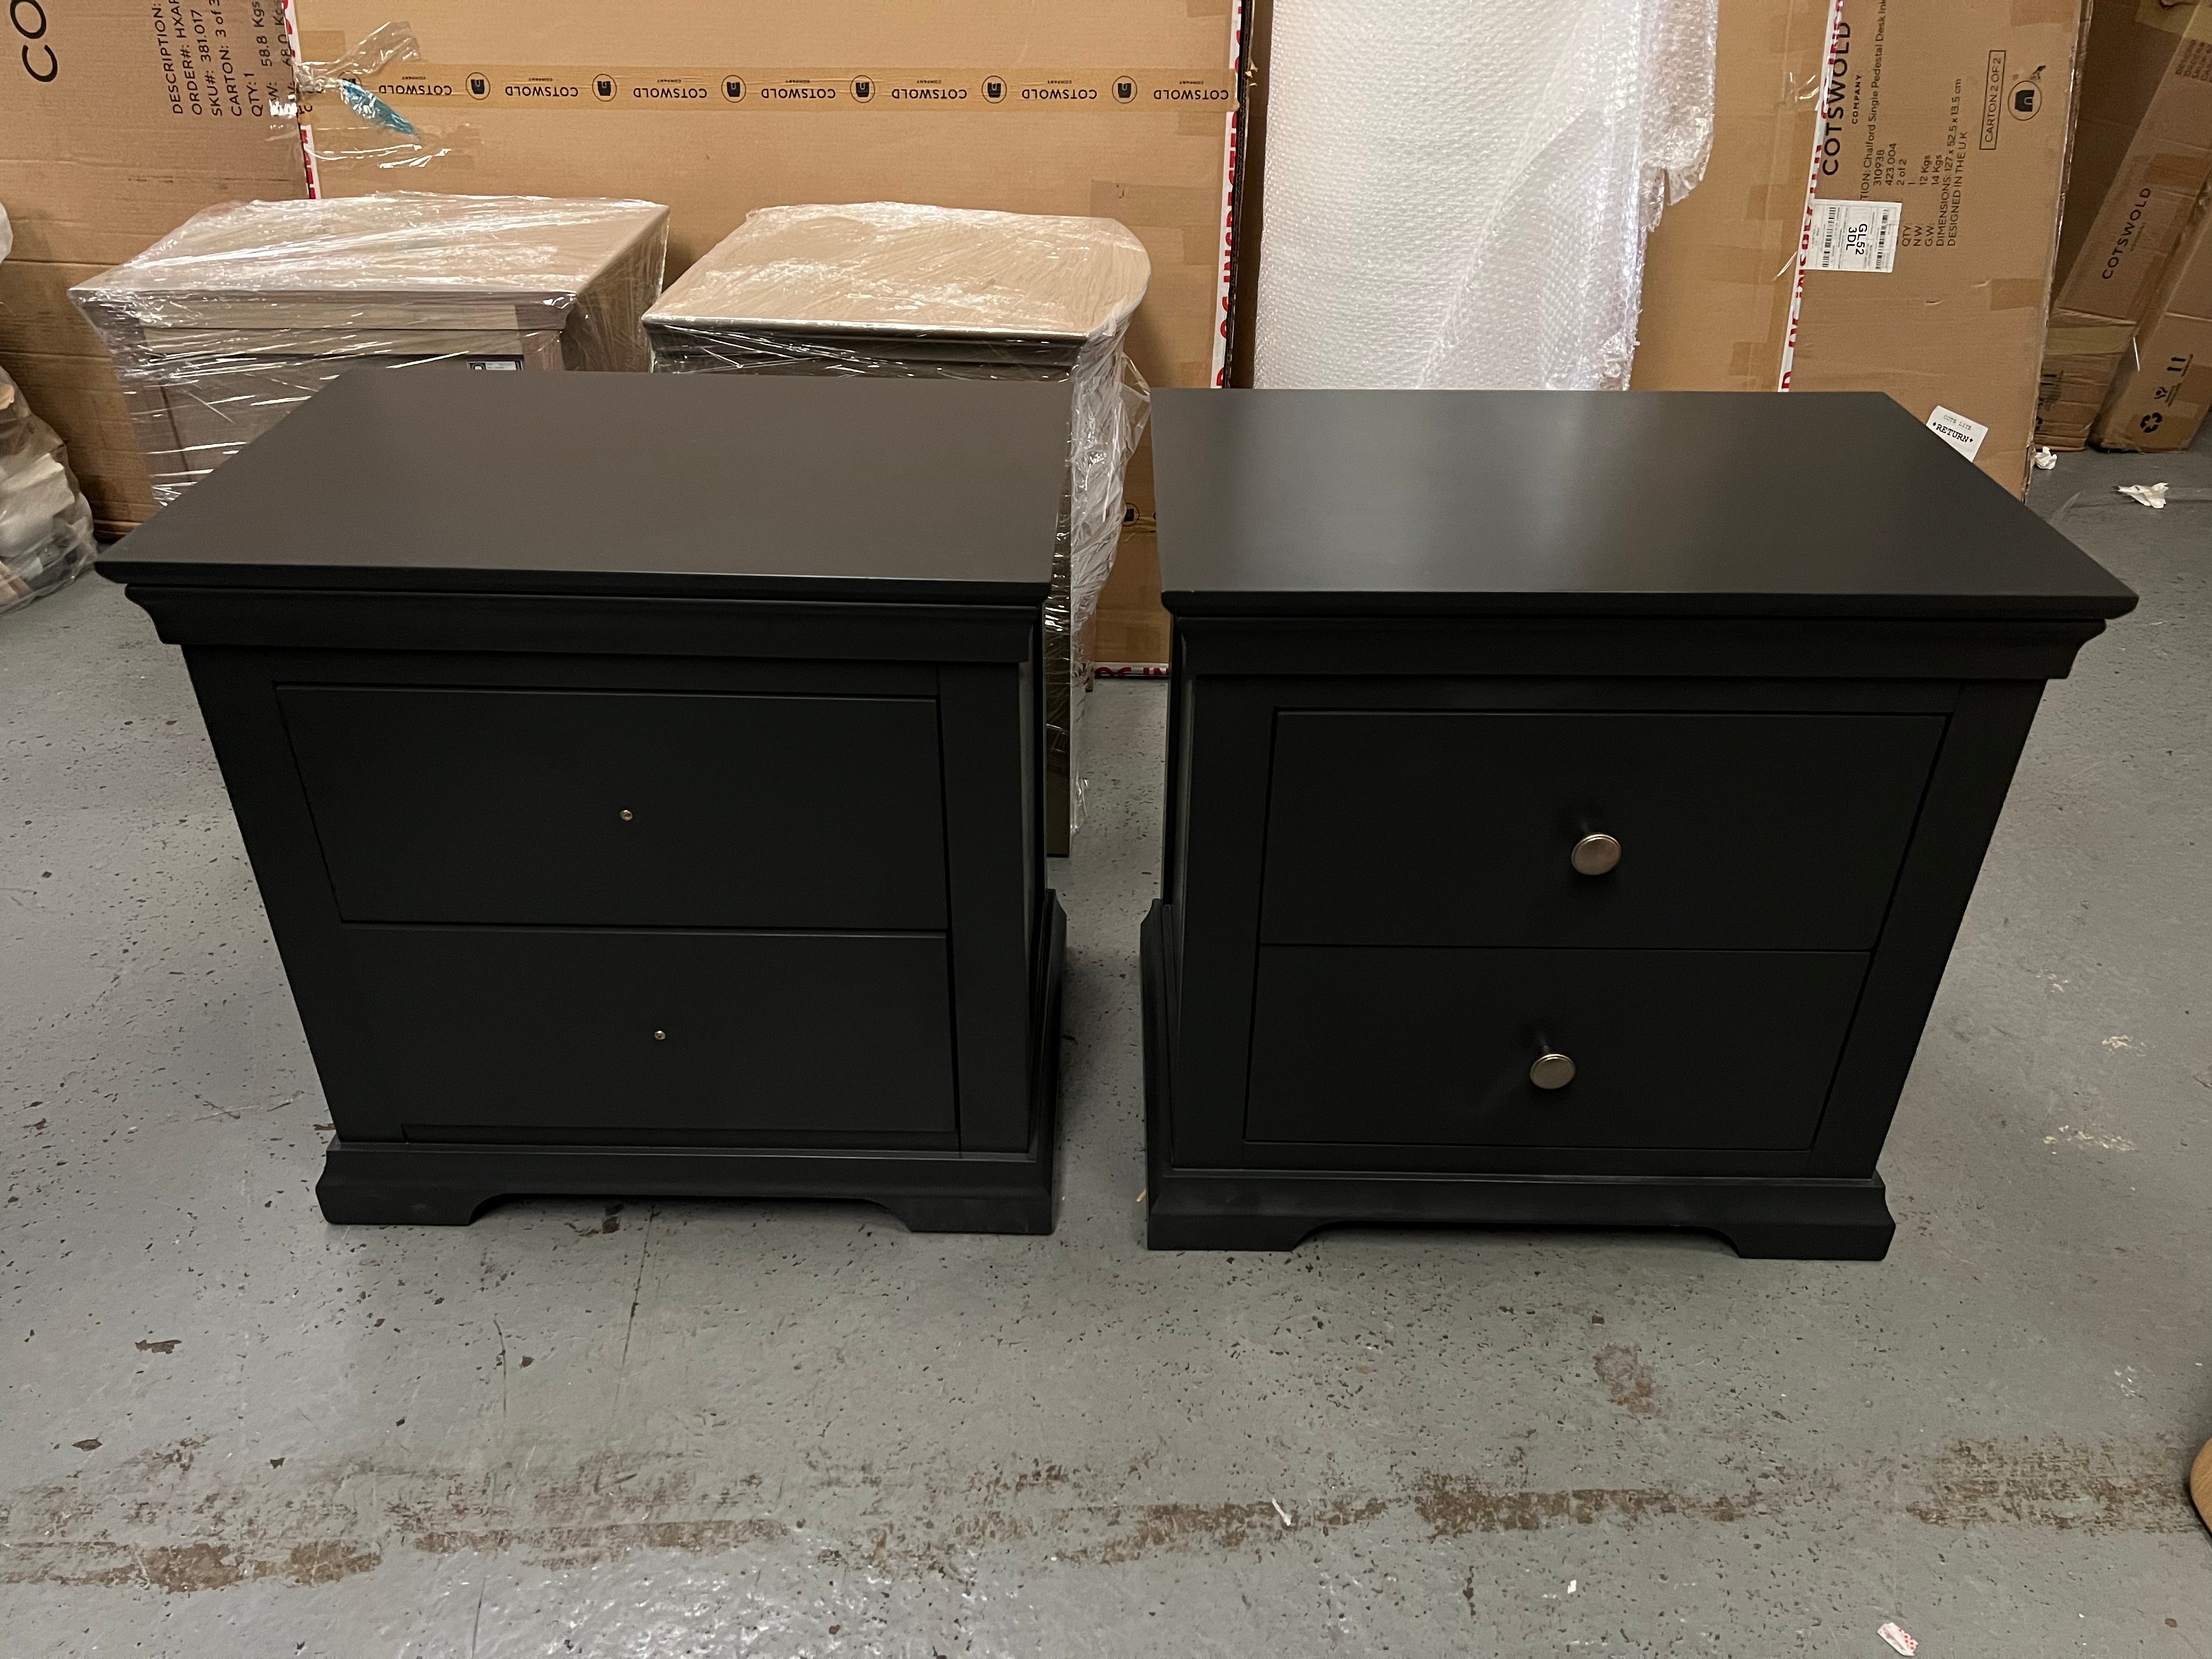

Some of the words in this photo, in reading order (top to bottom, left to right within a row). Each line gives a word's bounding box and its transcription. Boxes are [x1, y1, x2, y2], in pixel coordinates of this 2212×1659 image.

[210, 10, 224, 25] of
[252, 2, 265, 27] Kgs
[190, 9, 211, 63] 381.017
[215, 29, 226, 37] 3
[1875, 15, 1886, 42] Desk
[151, 3, 183, 114] DESCRIPTION:
[256, 36, 272, 66] 58.8
[1871, 44, 1883, 88] Pedestal
[179, 44, 202, 115] ORDER#:
[219, 45, 242, 116] CARTON:
[379, 85, 452, 95] COTSWOLD
[505, 86, 579, 97] COTSWOLD
[205, 70, 223, 116] SKU#:
[246, 82, 263, 117] QTY:
[633, 88, 707, 98] COTSWOLD
[761, 88, 836, 99] COTSWOLD
[891, 89, 967, 99] COTSWOLD
[1022, 89, 1097, 99] COTSWOLD
[1153, 89, 1229, 100] COTSWOLD
[1822, 22, 1850, 176] COTSWOLD
[1852, 75, 1861, 124] COMPANY
[1985, 94, 1997, 143] CARTON
[1991, 66, 2000, 82] OF
[1868, 91, 1880, 122] Single
[1945, 156, 1953, 171] 127
[1955, 78, 1962, 94] cm
[1898, 168, 1906, 177] of
[1921, 155, 1932, 173] Kgs
[1933, 154, 1943, 172] Kgs
[1955, 152, 1965, 173] THE
[1919, 176, 1928, 185] 12
[1932, 176, 1939, 185] 14
[1954, 176, 1962, 187] IN
[1948, 190, 1961, 246] DESIGNED
[1846, 227, 1858, 251] 3DL
[1855, 223, 1867, 255] GL52
[2102, 188, 2151, 279] COTSWOLD
